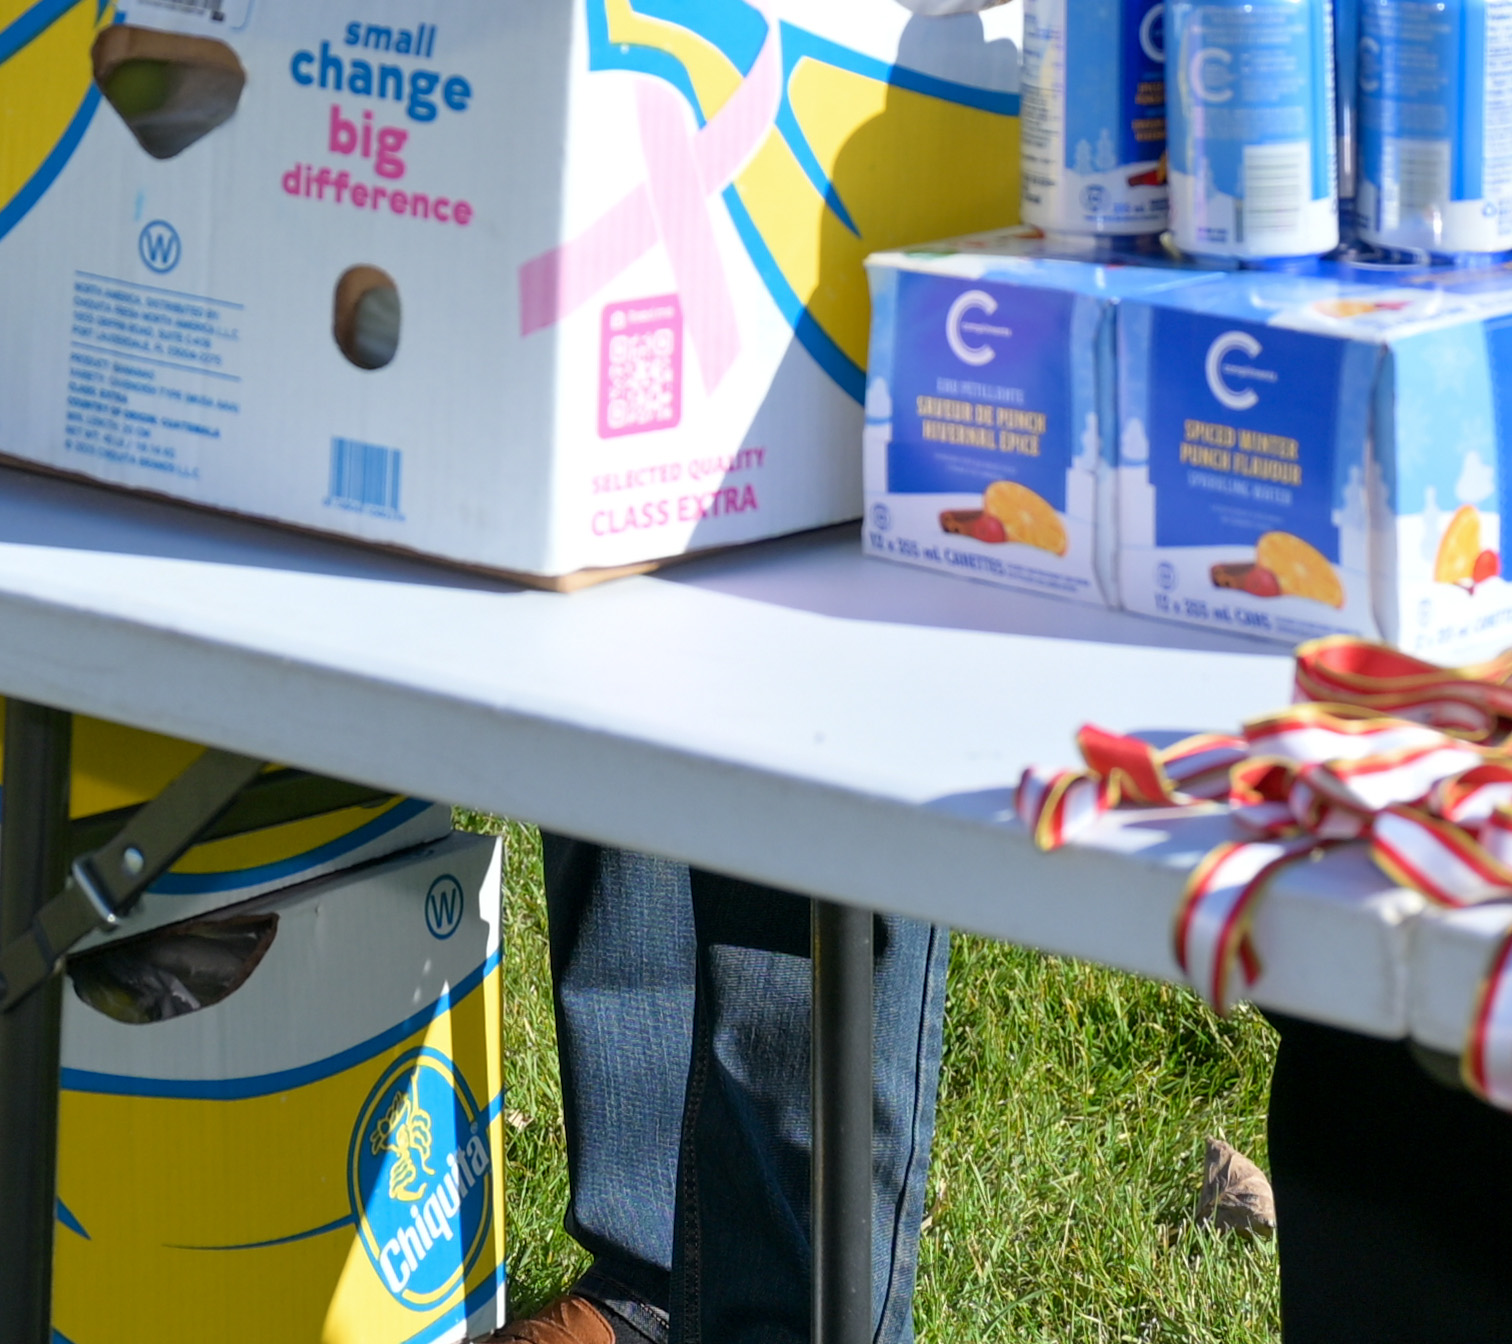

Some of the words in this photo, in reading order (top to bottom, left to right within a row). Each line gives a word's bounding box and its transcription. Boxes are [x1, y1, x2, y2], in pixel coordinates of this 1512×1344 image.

[344, 21, 436, 57] small
[290, 39, 472, 123] change
[329, 104, 408, 179] big
[282, 163, 473, 226] difference
[975, 403, 995, 426] DE
[996, 407, 1047, 435] PUNCH
[1184, 418, 1237, 448] SPICED
[1238, 428, 1300, 461] WINTER
[592, 461, 681, 494] SELECTED
[688, 446, 767, 480] QUALITY
[1179, 441, 1232, 472] PUNCH
[1233, 452, 1303, 487] FLAVOUR
[591, 499, 669, 537] CLASS
[678, 484, 758, 522] EXTRA
[380, 1136, 490, 1293] Chiquita
